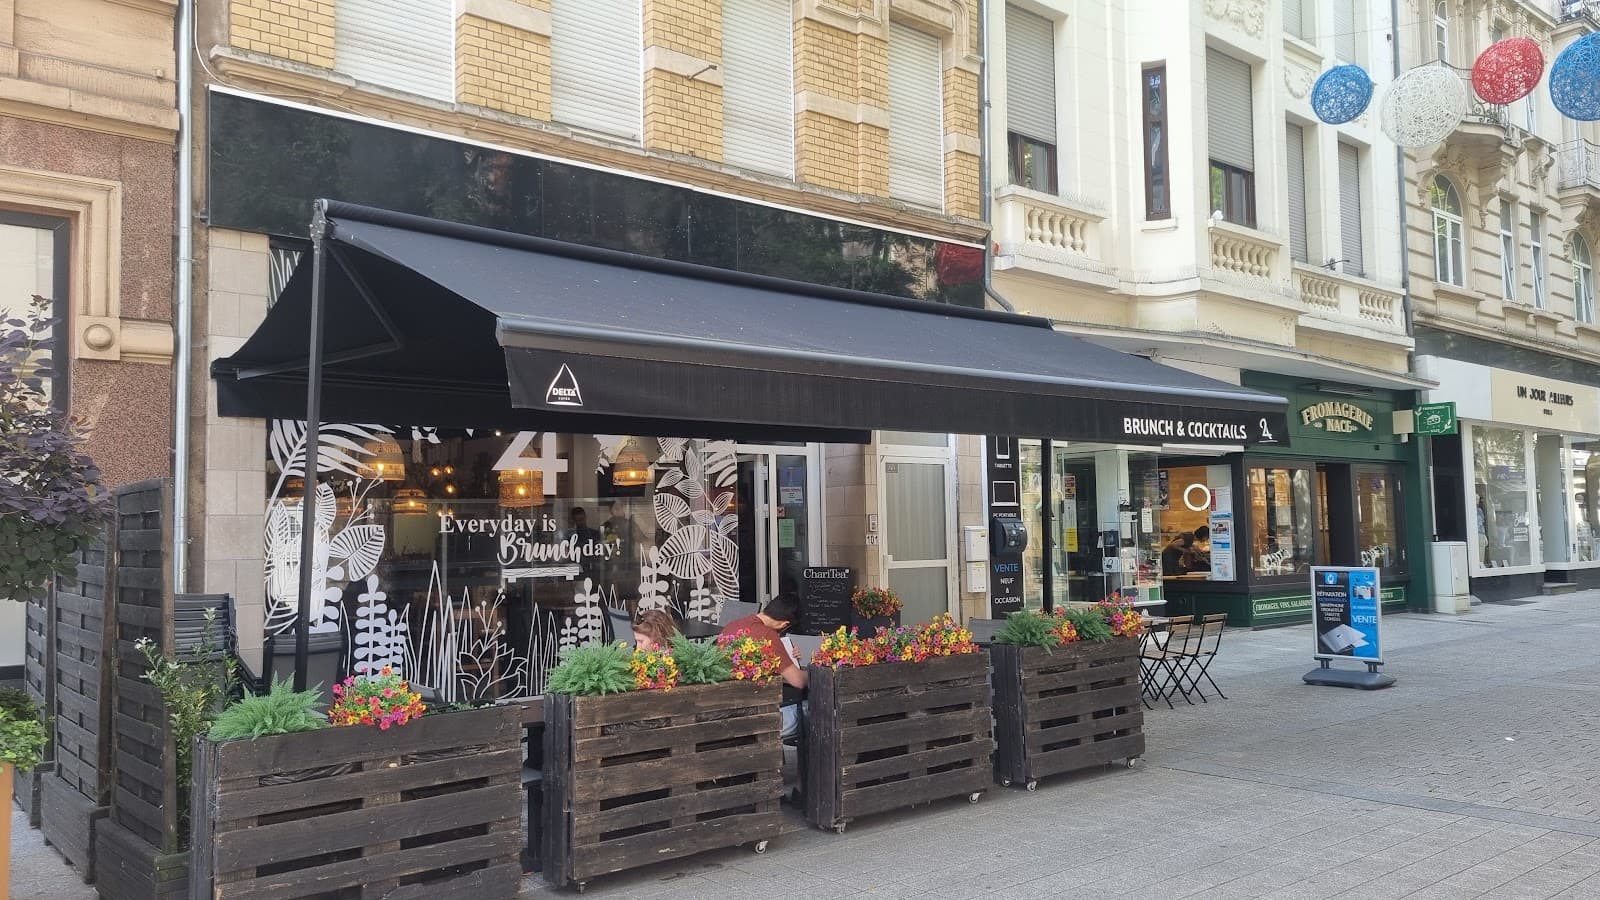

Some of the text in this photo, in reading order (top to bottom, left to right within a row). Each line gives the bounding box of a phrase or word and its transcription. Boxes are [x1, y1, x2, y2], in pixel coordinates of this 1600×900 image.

[552, 387, 577, 397] DELTA
[1517, 386, 1527, 398] UN
[1530, 388, 1546, 402] JOUR
[1301, 402, 1374, 431] FROMAGERIE
[1123, 417, 1247, 440] BRUNCH & COCKTAILS
[491, 431, 568, 496] 4
[439, 513, 557, 538] Everyday is
[803, 568, 849, 579] ChariTea
[994, 563, 1019, 573] VENTE
[1000, 577, 1015, 585] NEUF
[1352, 615, 1377, 624] VENTE
